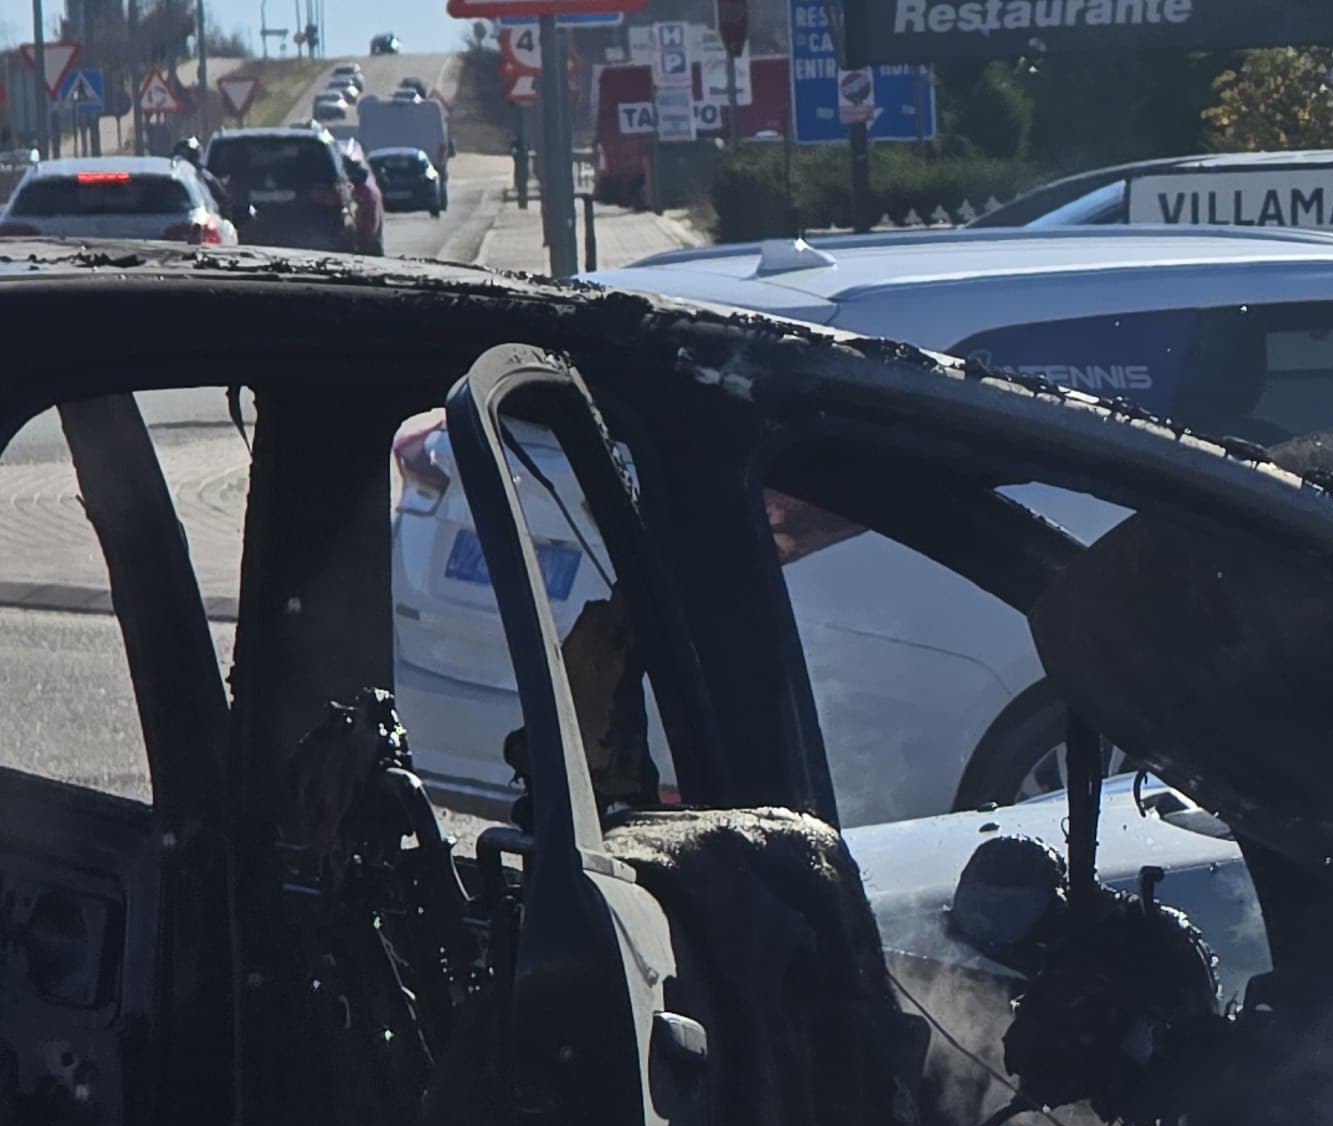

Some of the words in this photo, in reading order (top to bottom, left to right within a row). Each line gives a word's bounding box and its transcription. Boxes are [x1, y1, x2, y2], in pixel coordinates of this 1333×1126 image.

[796, 7, 829, 27] RES
[894, 0, 1192, 33] Restaurante
[809, 33, 835, 52] CA
[796, 58, 837, 80] ENTR
[622, 104, 718, 129] TAO
